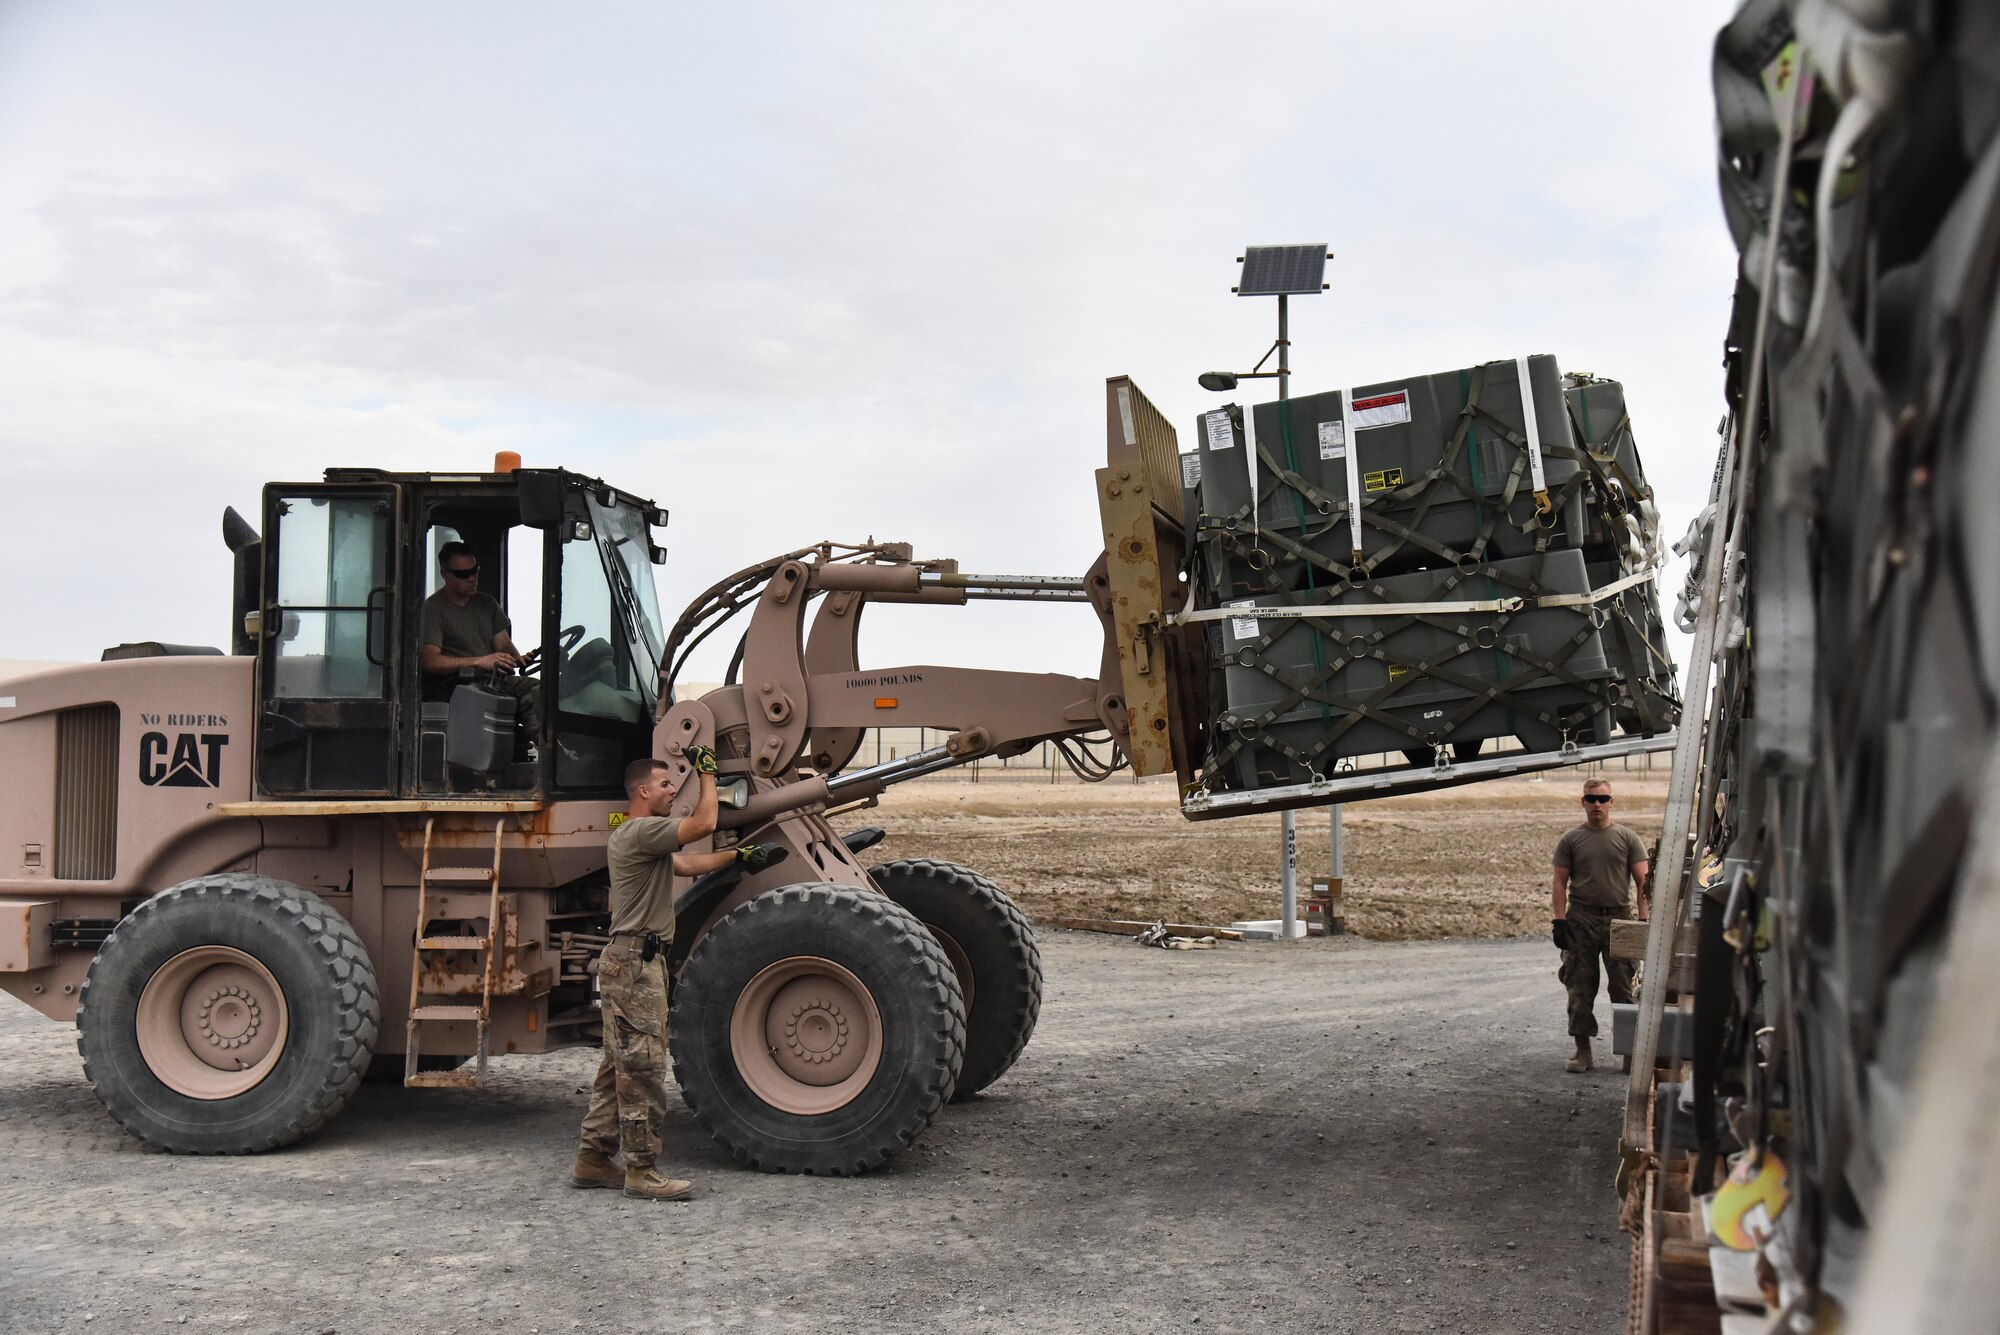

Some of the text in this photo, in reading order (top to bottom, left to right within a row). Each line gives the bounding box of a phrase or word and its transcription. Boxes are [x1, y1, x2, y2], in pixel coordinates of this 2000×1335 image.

[846, 673, 922, 688] 10000 POUNDS
[141, 713, 227, 727] NO RIDERS
[139, 731, 228, 788] CAT
